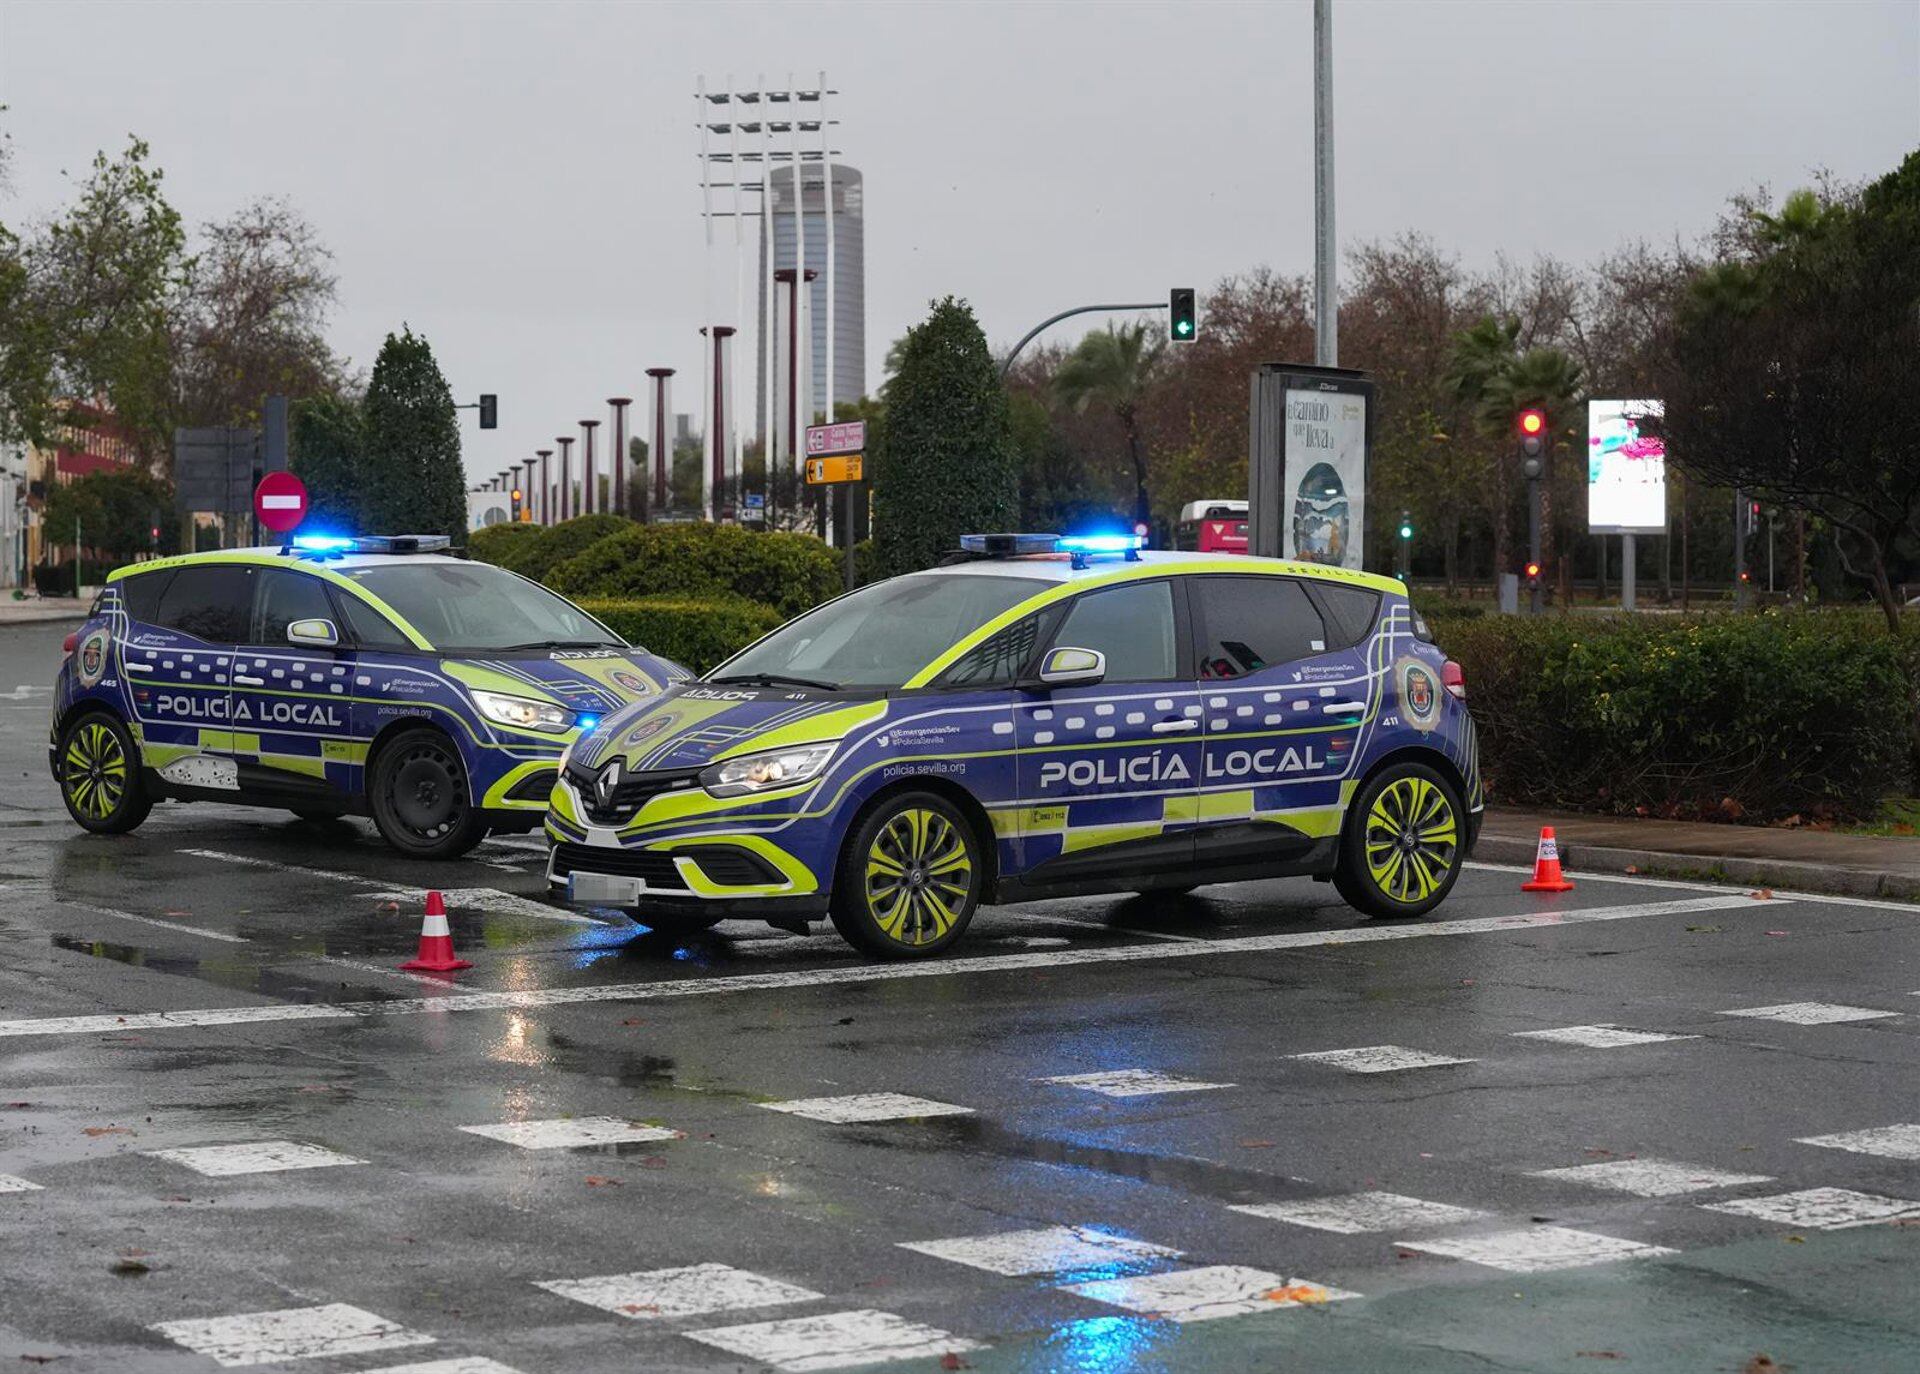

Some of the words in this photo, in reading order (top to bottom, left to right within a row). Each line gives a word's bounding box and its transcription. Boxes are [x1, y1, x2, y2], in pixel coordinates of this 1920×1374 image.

[1294, 398, 1329, 422] camino
[1287, 567, 1366, 578] SEVILLA
[157, 694, 252, 720] POLICÍA
[260, 701, 342, 727] LOCAL
[1382, 717, 1398, 726] 411
[889, 725, 960, 738] @EmergenciasSev
[883, 762, 966, 779] policia.sevilla.org
[1040, 749, 1191, 788] POLICÍA
[1206, 745, 1325, 778] LOCAL
